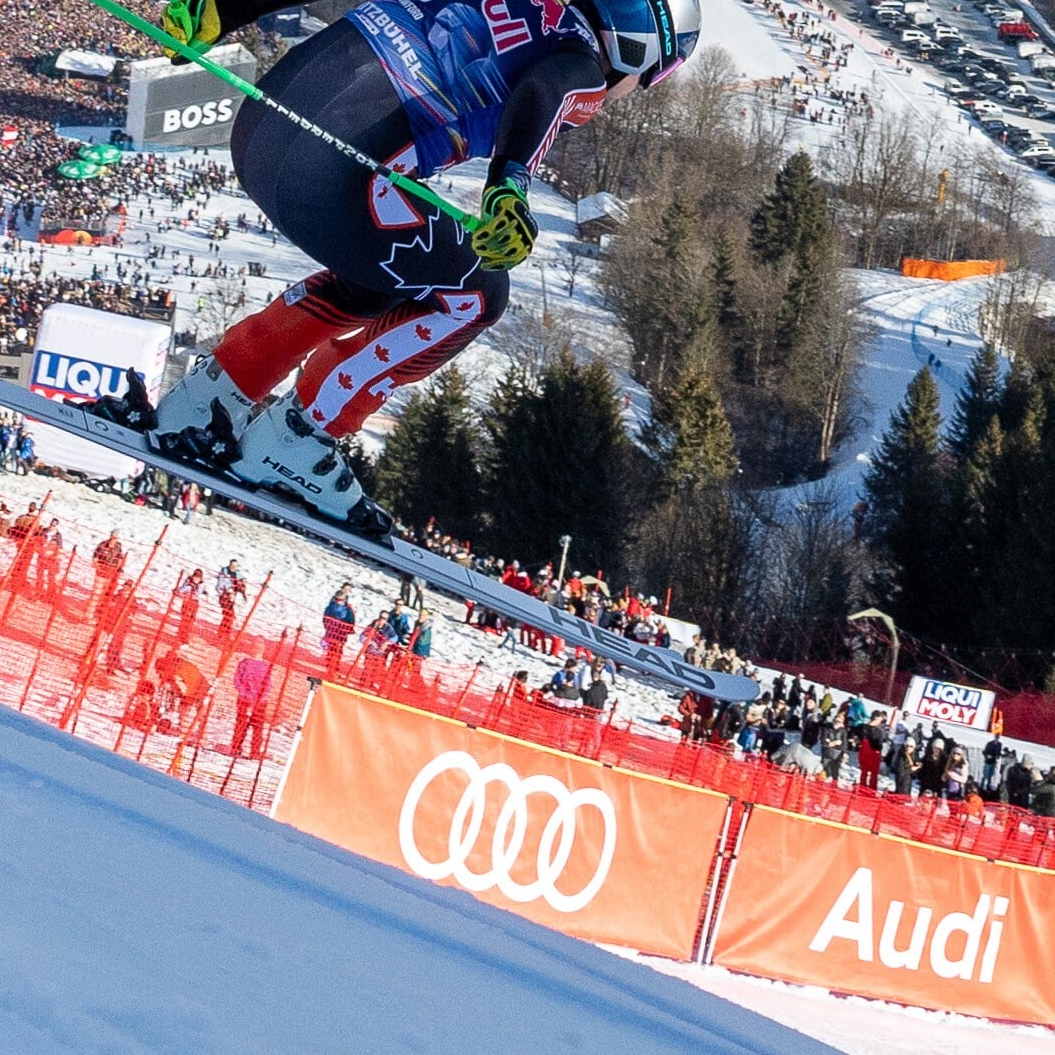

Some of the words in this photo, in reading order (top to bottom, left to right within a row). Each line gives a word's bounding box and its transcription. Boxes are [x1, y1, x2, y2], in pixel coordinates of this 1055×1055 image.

[657, 0, 672, 56] HEAD
[163, 98, 234, 133] BOSS
[36, 353, 130, 399] LIQU
[262, 455, 323, 494] HEAD
[548, 606, 716, 690] HEAD
[918, 698, 977, 724] MOLY
[925, 682, 981, 707] LIQUI
[808, 866, 1010, 984] Audi
